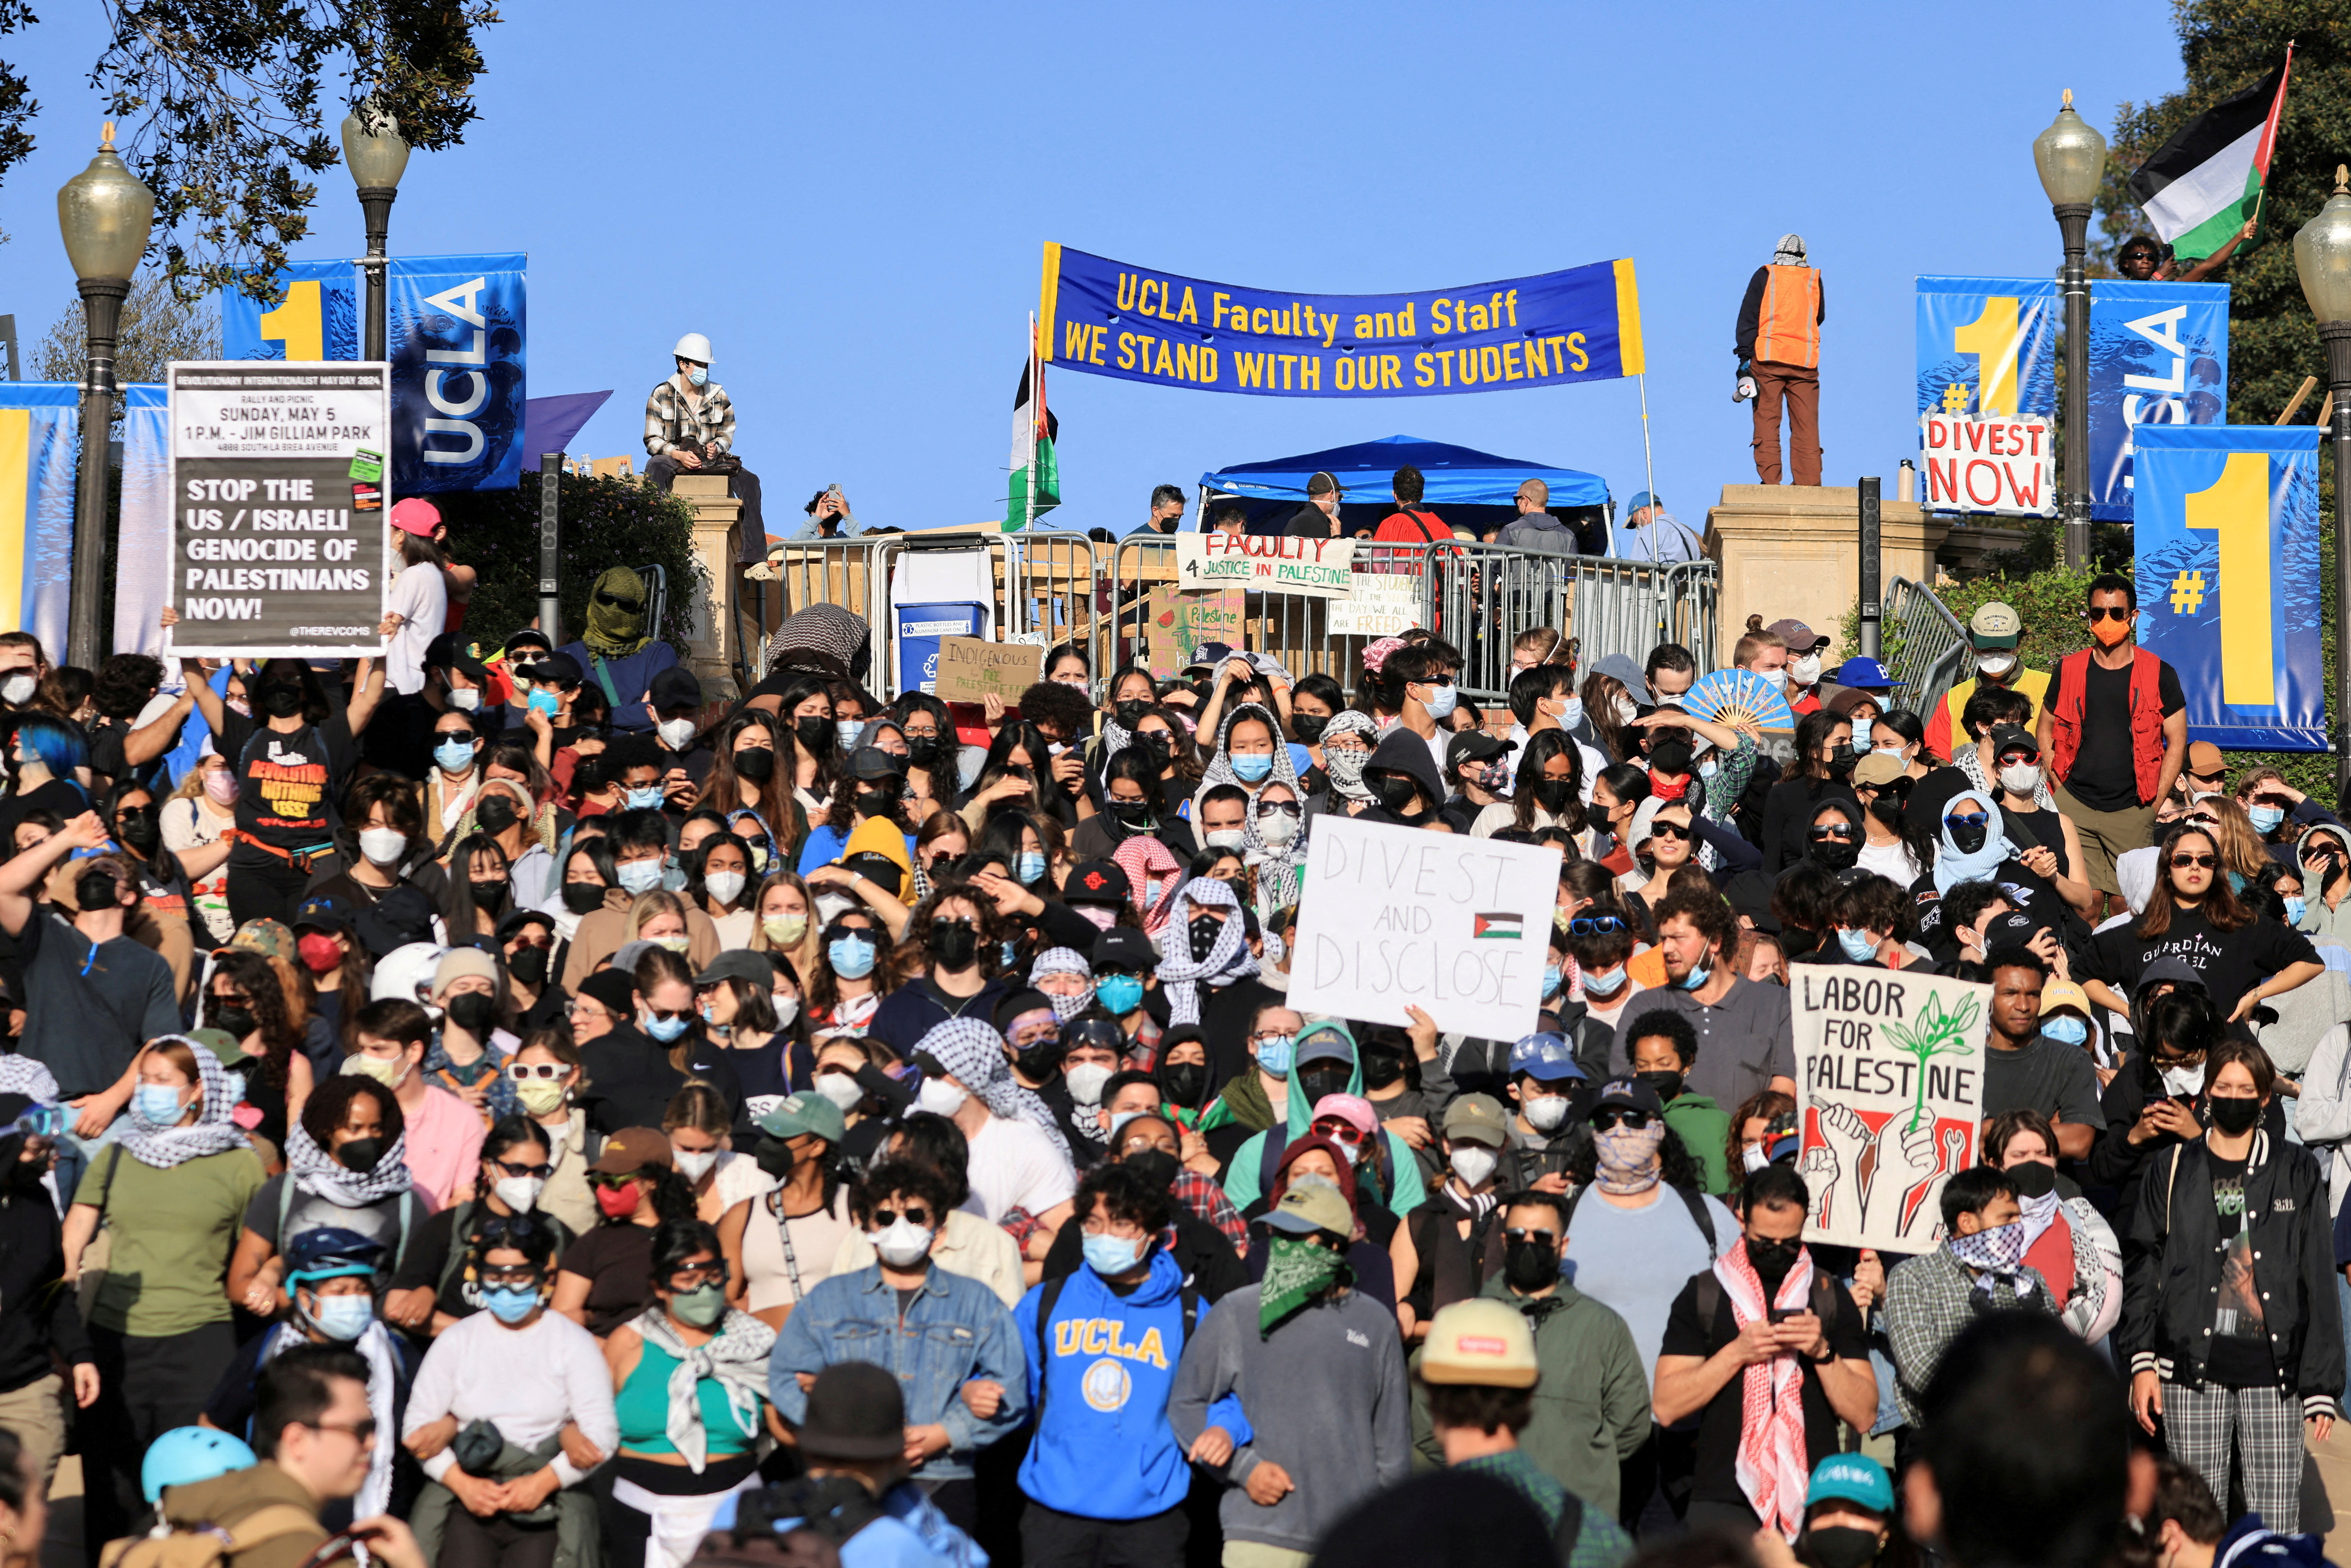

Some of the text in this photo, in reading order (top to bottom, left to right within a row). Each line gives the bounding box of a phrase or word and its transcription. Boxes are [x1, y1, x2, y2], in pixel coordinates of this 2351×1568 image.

[1117, 273, 1518, 347] UCLA Faculty and Staff
[1066, 321, 1589, 391] WE STAND WITH OUR STUDENTS
[1943, 297, 2018, 417] #1
[177, 376, 242, 385] REVOLUTIONARY
[244, 376, 318, 385] INTERNATIONALIST
[358, 376, 380, 384] 2024
[424, 276, 486, 468] UCLA
[241, 395, 314, 404] RALLY AND PICNIC
[2123, 305, 2187, 488] CLA
[220, 407, 336, 422] SUNDAY, MAY 5
[186, 426, 191, 439] 1
[197, 426, 225, 440] P.M.
[240, 426, 265, 440] JIM
[270, 426, 327, 440] GILLIAM
[332, 425, 371, 440] PARK
[1928, 419, 2045, 457] DIVEST
[242, 443, 268, 451] SOUTH
[270, 443, 280, 451] LA
[282, 443, 303, 451] BREA
[305, 443, 338, 451] AVENUE
[187, 479, 314, 501] STOP THE
[1929, 457, 2042, 507] NOW
[186, 509, 349, 531] US / ISRAELI
[187, 539, 358, 561] GENOCIDE OF
[1206, 534, 1331, 562] FACULTY
[186, 568, 370, 590] PALESTINIANS
[1186, 559, 1351, 584] 4 JUSTICE IN PALESTINE
[2170, 453, 2275, 705] #1
[1356, 574, 1423, 592] THE STUDENTS
[1386, 593, 1407, 602] SEED
[186, 598, 262, 620] NOW!
[1331, 603, 1408, 615] THE DAY WE ALL
[289, 626, 370, 636] @THEREVCOMS
[1333, 615, 1402, 633] ARE FREED
[948, 643, 1028, 666] INDIGENOUS
[983, 669, 1001, 683] FREE
[1875, 664, 1889, 680] B
[1455, 747, 1466, 758] HOCKEY
[1456, 750, 1471, 763] EVERYONE
[261, 779, 323, 803] NOTHING
[272, 799, 310, 818] LESS!
[1324, 833, 1517, 908] DIVEST
[1373, 905, 1432, 934] AND
[2142, 939, 2222, 963] GUARDIAN
[1314, 933, 1523, 1009] DISCLOSE
[1804, 975, 1906, 1018] LABOR
[2052, 988, 2075, 996] UCLA
[1824, 1020, 1873, 1051] FOR
[2274, 1198, 2295, 1213] Bill
[1055, 1317, 1168, 1371] UCLA
